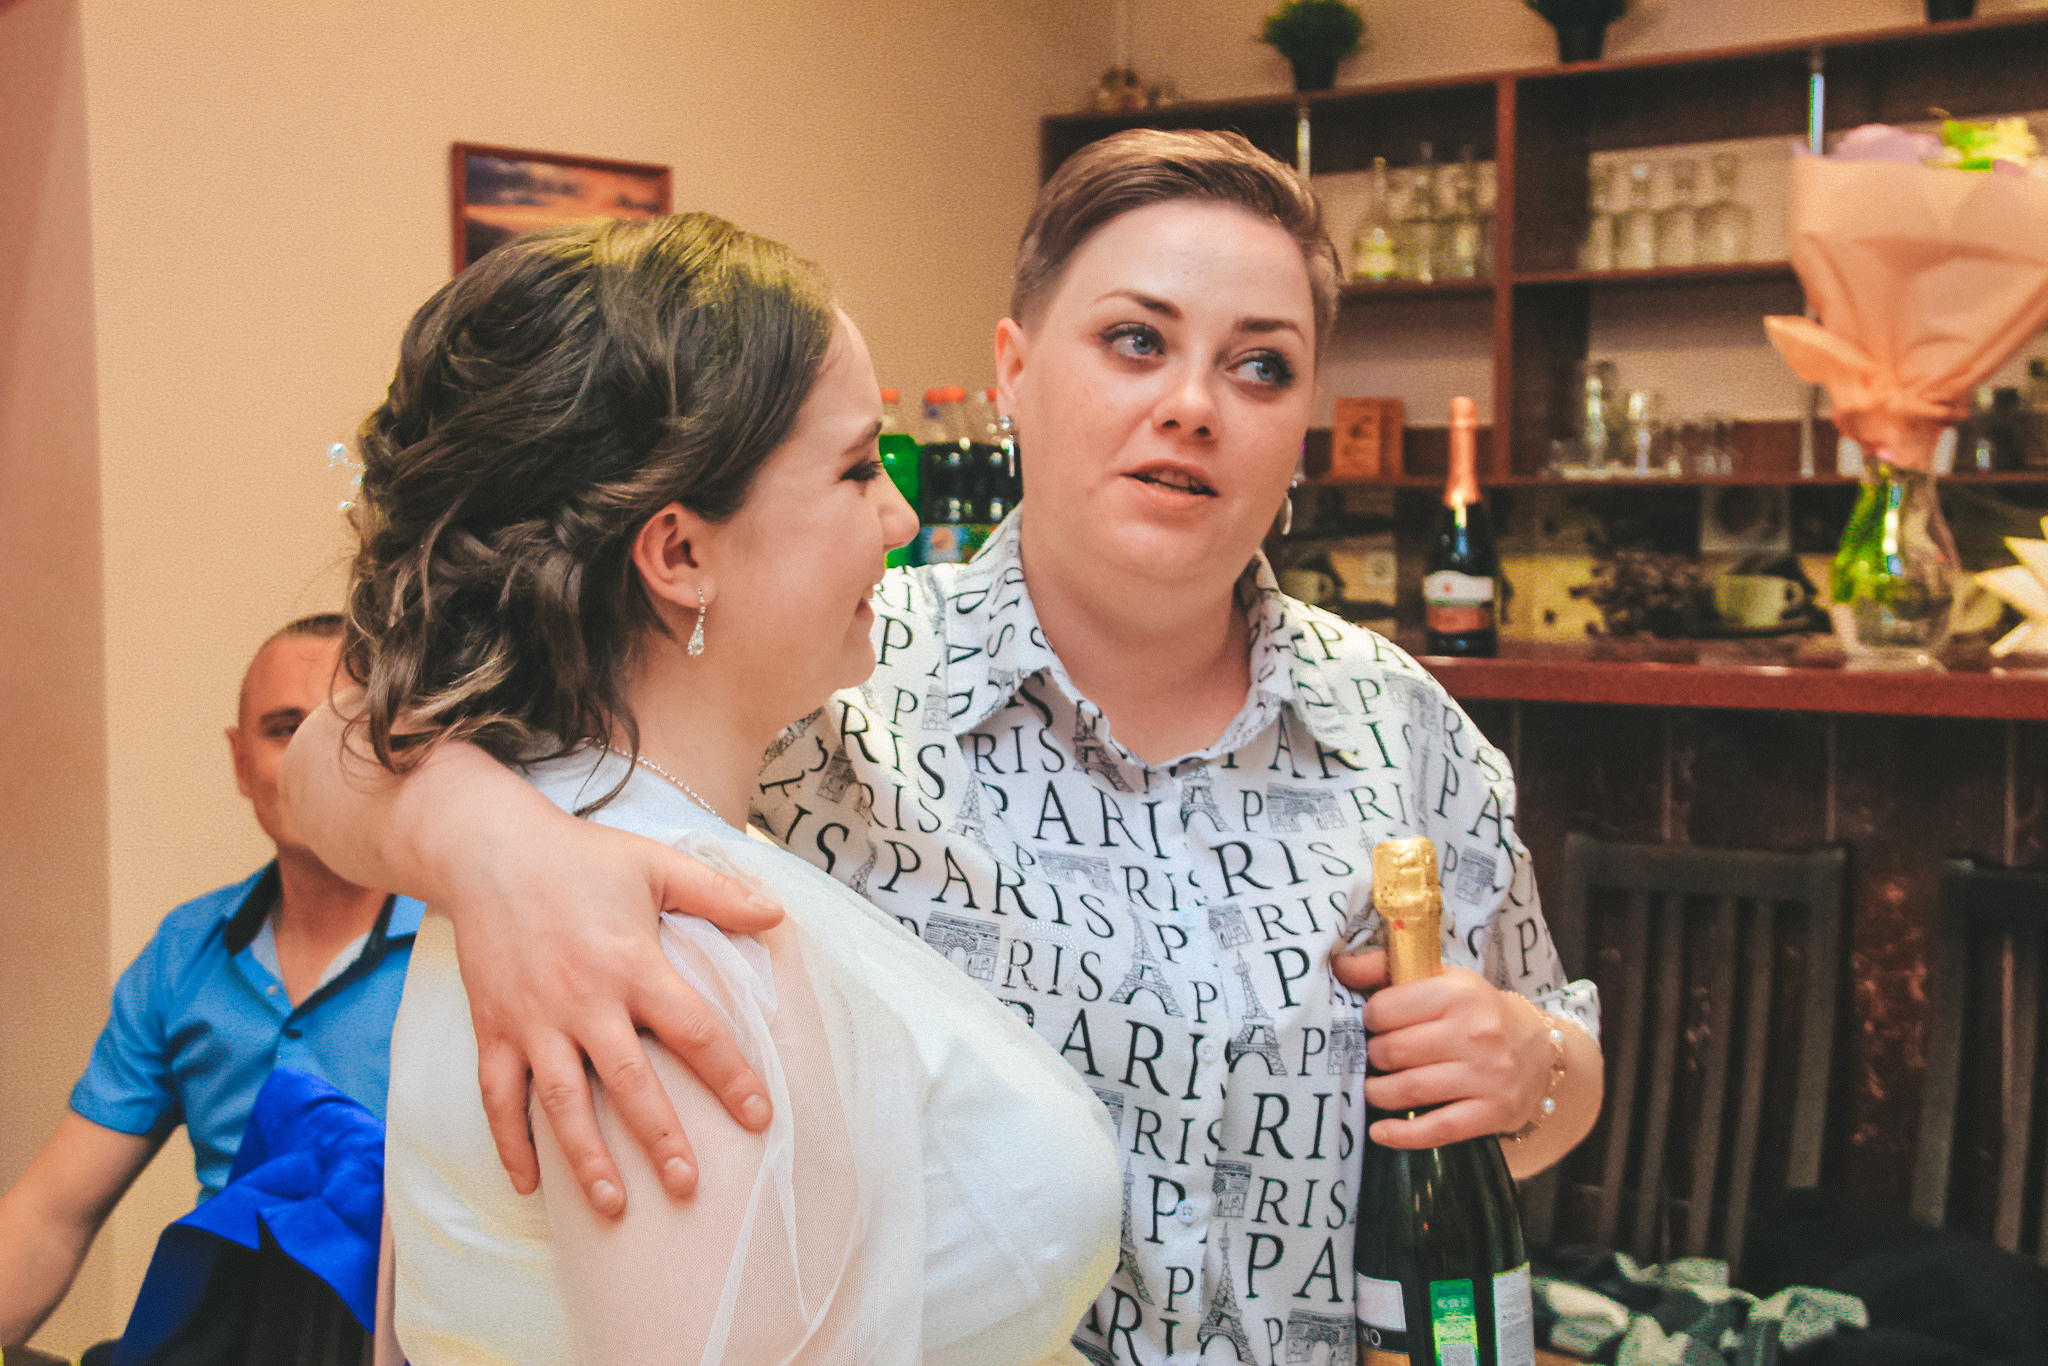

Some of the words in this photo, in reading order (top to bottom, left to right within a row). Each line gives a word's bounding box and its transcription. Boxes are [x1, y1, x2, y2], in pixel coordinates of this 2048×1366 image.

[971, 725, 1065, 775] RIS
[878, 839, 1115, 939] PARIS
[1209, 838, 1354, 899] RIS
[1001, 938, 1102, 1002] RIS
[1250, 1175, 1348, 1231] RIS
